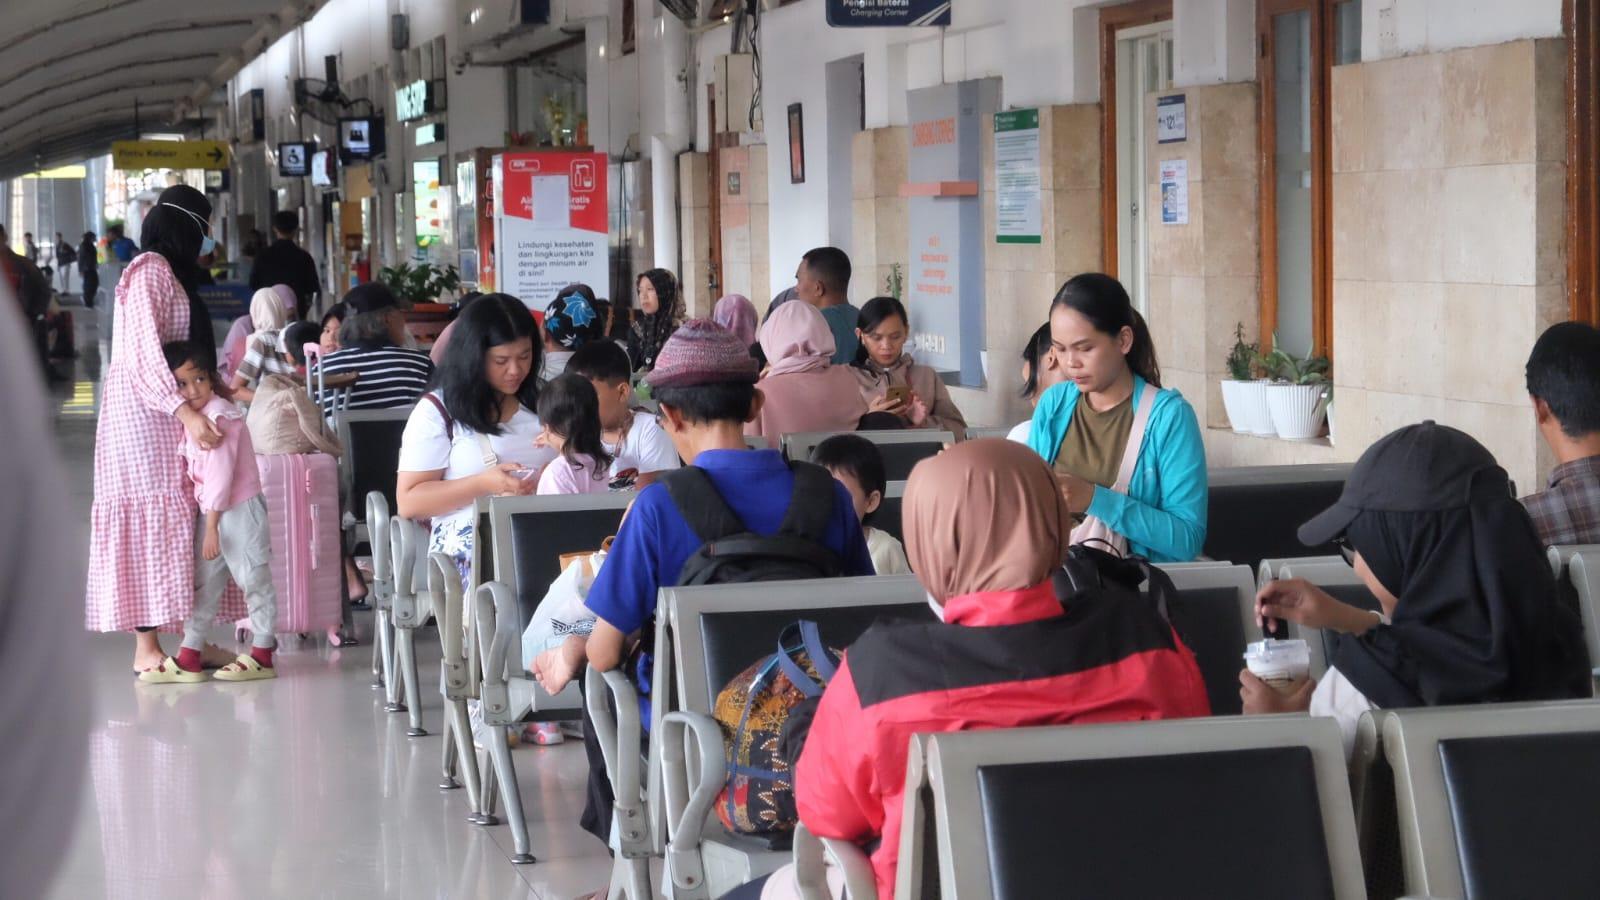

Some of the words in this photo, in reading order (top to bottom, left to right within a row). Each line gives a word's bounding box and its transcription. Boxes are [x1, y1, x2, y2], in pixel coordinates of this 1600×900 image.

[850, 9, 882, 17] Charging
[518, 241, 553, 250] Lindungi
[534, 251, 578, 259] lingkungan
[518, 261, 547, 269] dengan
